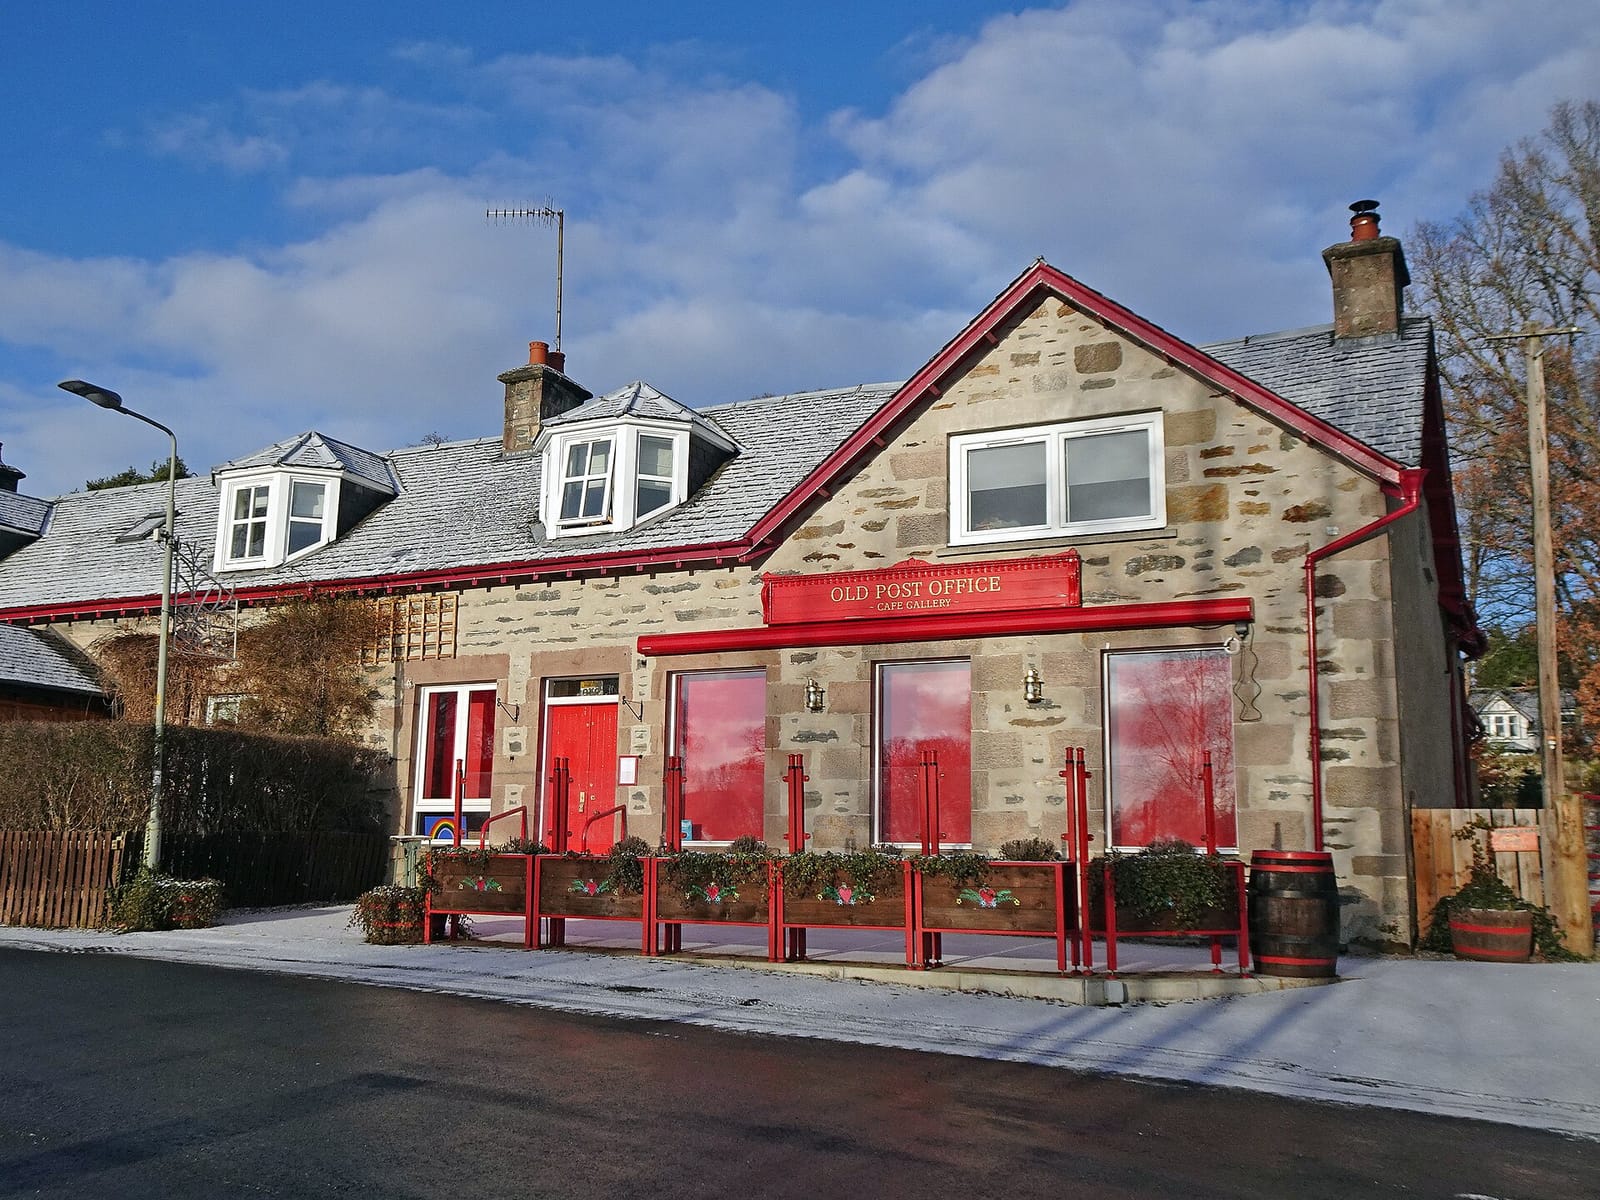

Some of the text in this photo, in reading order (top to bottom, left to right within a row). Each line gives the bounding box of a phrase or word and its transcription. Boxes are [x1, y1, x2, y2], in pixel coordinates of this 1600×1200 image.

[830, 576, 1001, 602] OLD POST OFFICE
[877, 598, 952, 611] CAFE GALLERY
